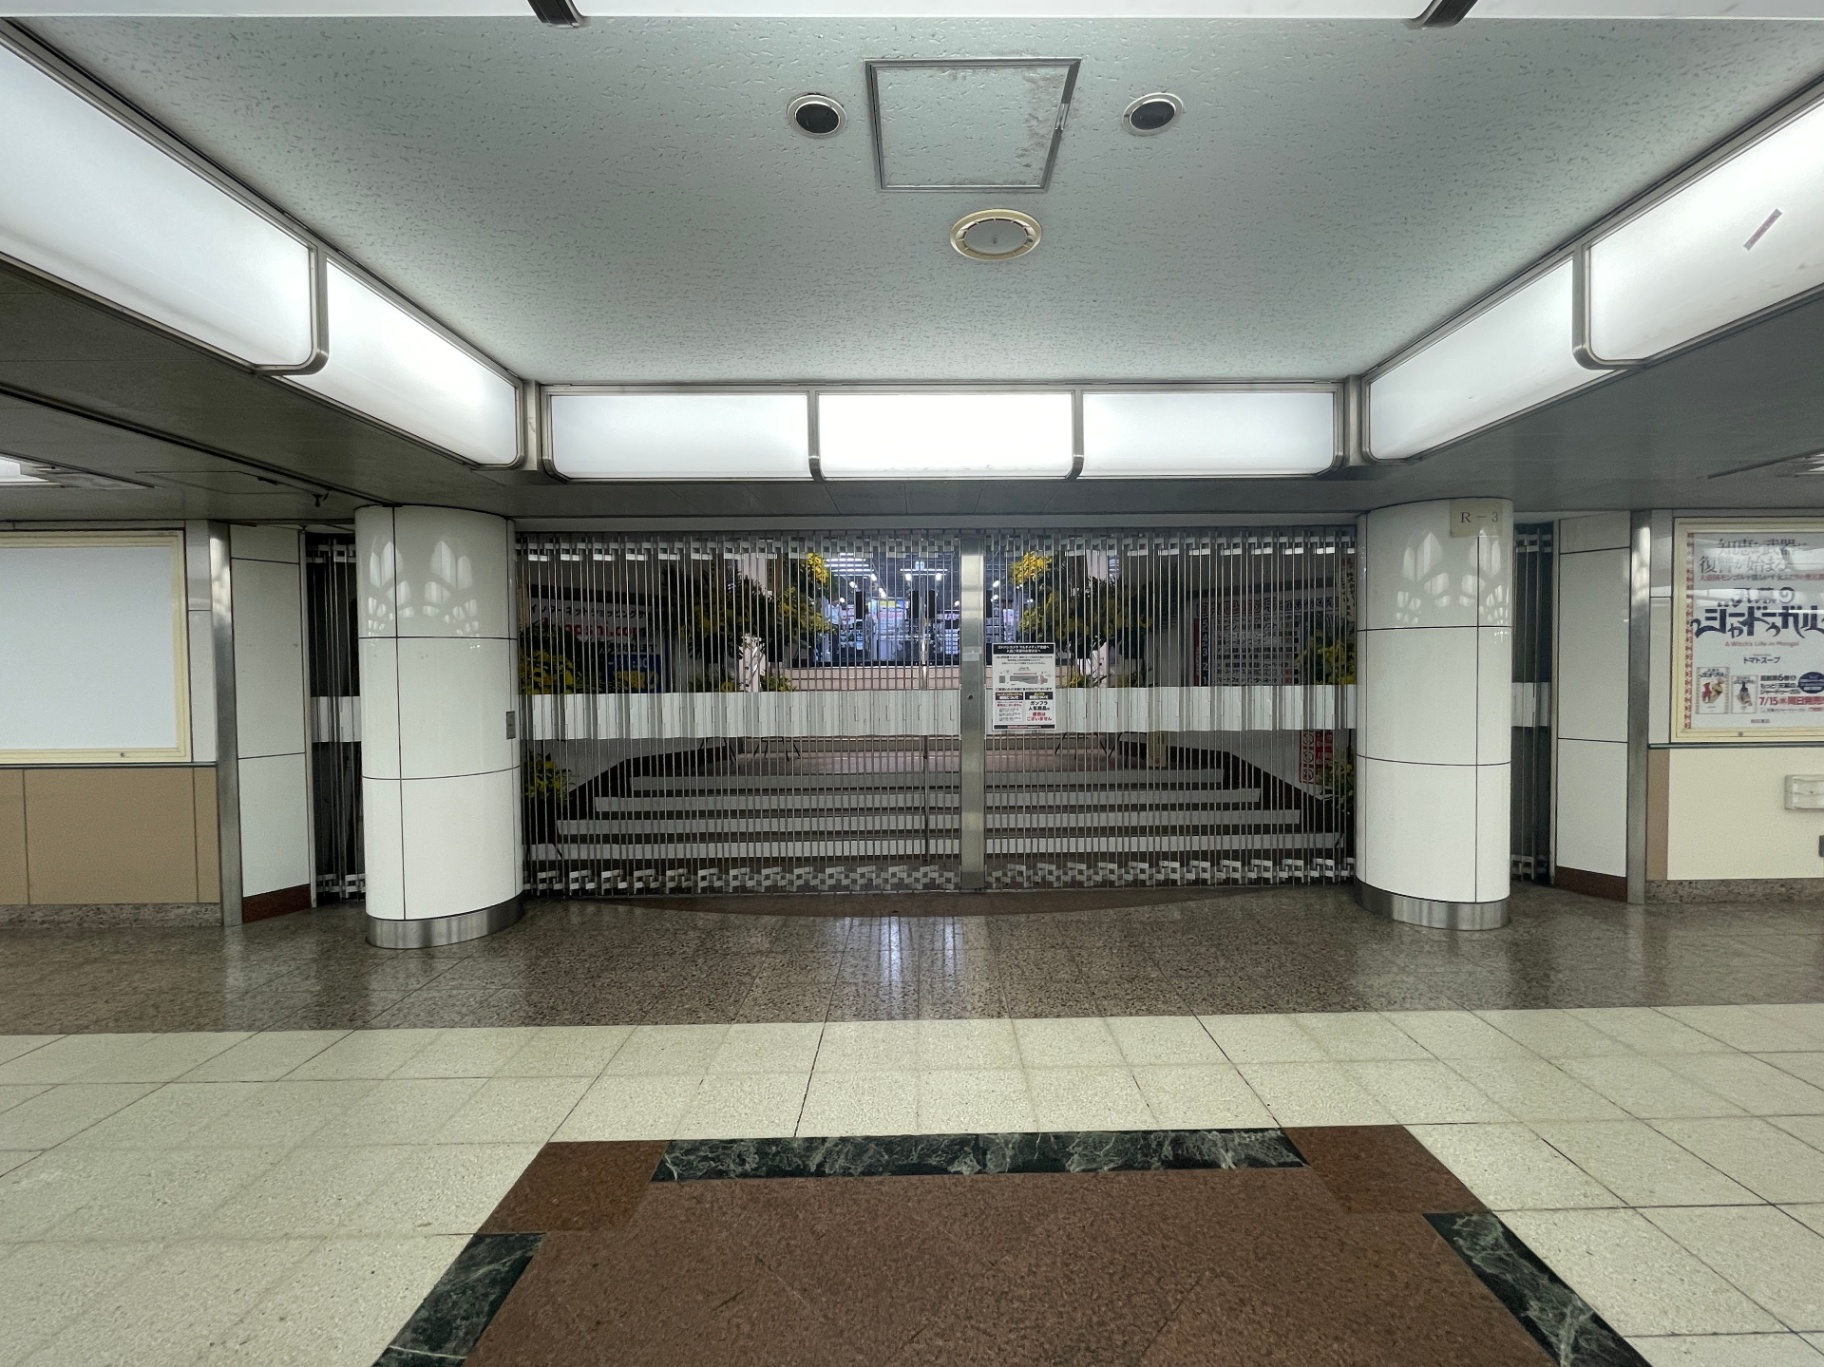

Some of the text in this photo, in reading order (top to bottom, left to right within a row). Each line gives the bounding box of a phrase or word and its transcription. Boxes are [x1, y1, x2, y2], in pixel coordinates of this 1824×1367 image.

[1743, 656, 1782, 664] トマトスープ
